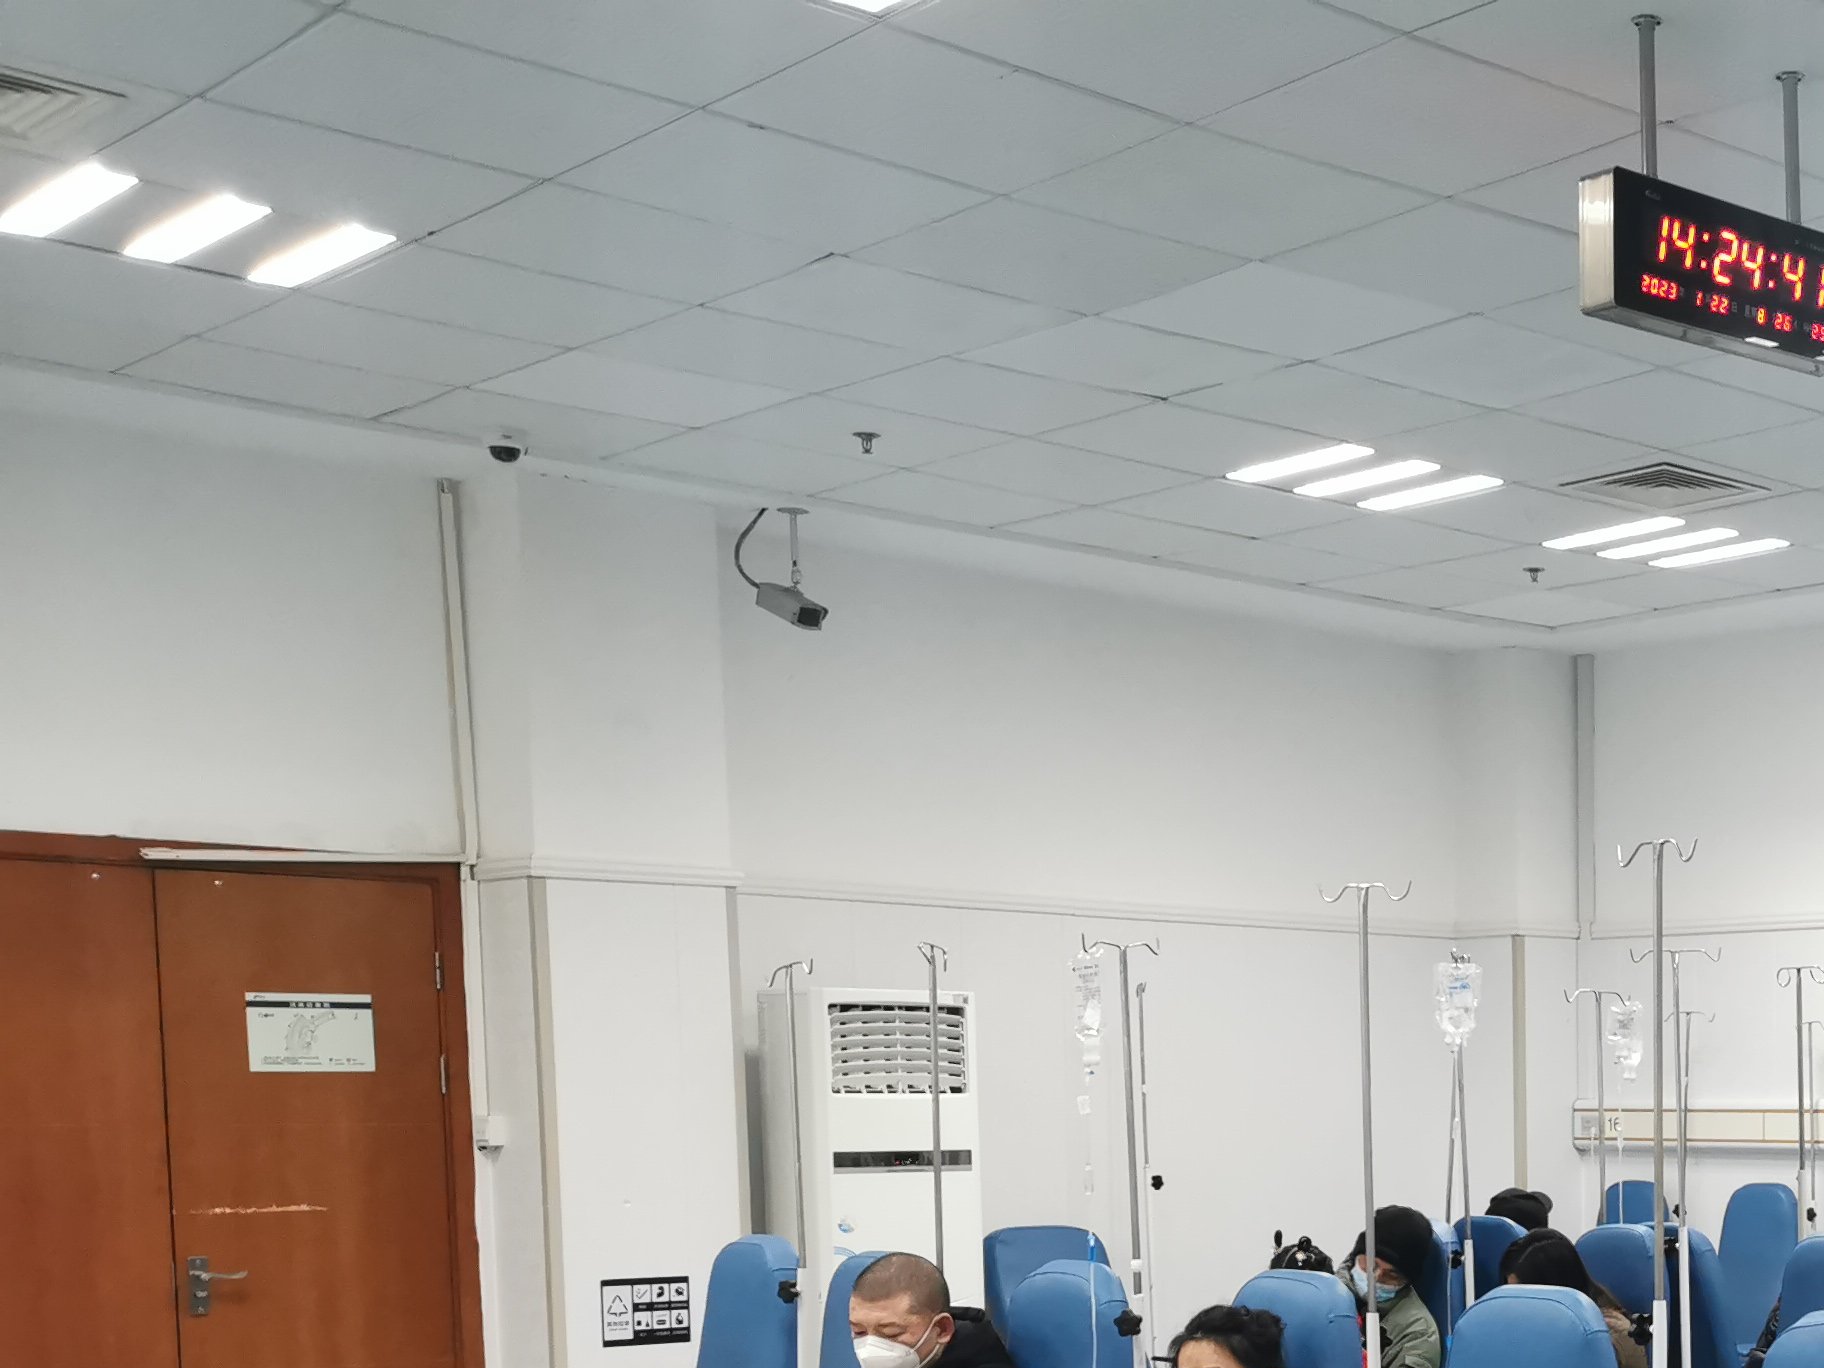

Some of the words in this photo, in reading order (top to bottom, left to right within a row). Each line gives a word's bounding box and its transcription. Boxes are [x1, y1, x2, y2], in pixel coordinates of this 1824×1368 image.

[1640, 274, 1679, 302] 2023
[1696, 290, 1703, 308] 1
[1709, 294, 1731, 316] 22
